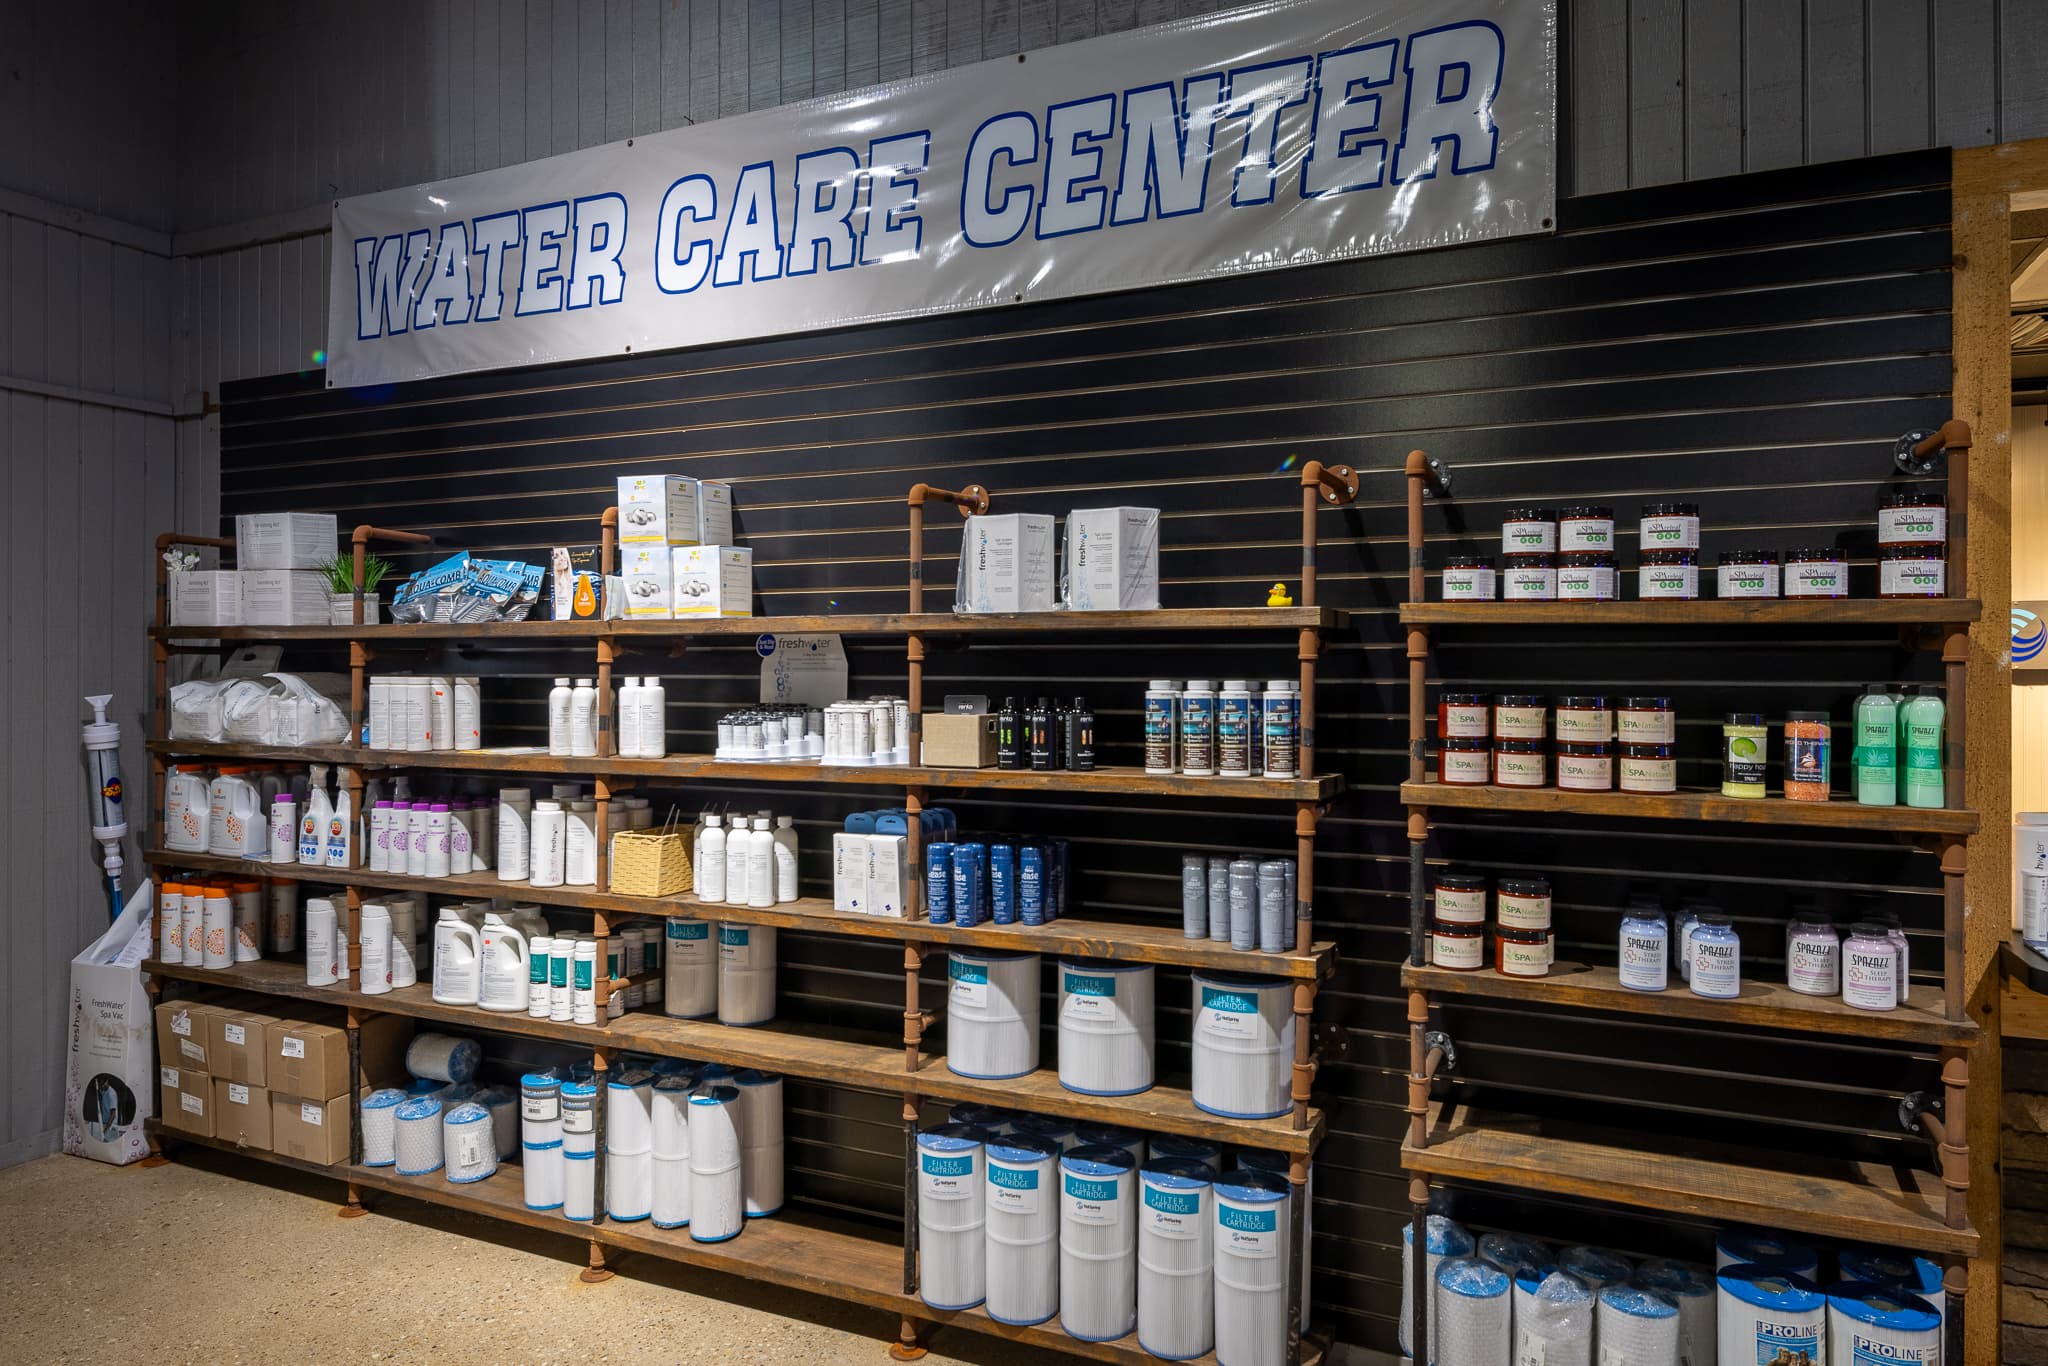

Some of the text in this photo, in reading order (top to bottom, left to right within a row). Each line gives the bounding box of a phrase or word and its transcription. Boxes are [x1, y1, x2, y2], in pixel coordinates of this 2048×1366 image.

[355, 18, 1506, 341] WATER CARE CENTER
[778, 637, 832, 651] freshwater
[2034, 840, 2046, 870] hwater
[1626, 937, 1661, 950] SPAZAZZ
[1795, 942, 1831, 956] SPAZAZZ
[1699, 944, 1733, 957] SPAZAZZ
[1851, 953, 1889, 968] SPAZAZZ
[1214, 993, 1241, 1003] FILTER
[1209, 1000, 1247, 1011] CARTRIDGE
[100, 1010, 123, 1020] Spa Vac
[928, 1165, 963, 1174] CARTRIDGE
[932, 1159, 958, 1168] FILTER
[993, 1175, 1028, 1187] CARTRIDGE
[997, 1170, 1023, 1180] FILTER
[1075, 1181, 1103, 1192] FILTER
[1071, 1187, 1108, 1199] CARTRIDGE
[1155, 1193, 1184, 1205] FILTER
[1151, 1199, 1189, 1212] CARTRIDGE
[1230, 1211, 1261, 1222] FILTER
[1226, 1218, 1266, 1231] CARTRIDGE
[1762, 1322, 1817, 1338] PROLINE
[1858, 1336, 1922, 1361] PROLINE
